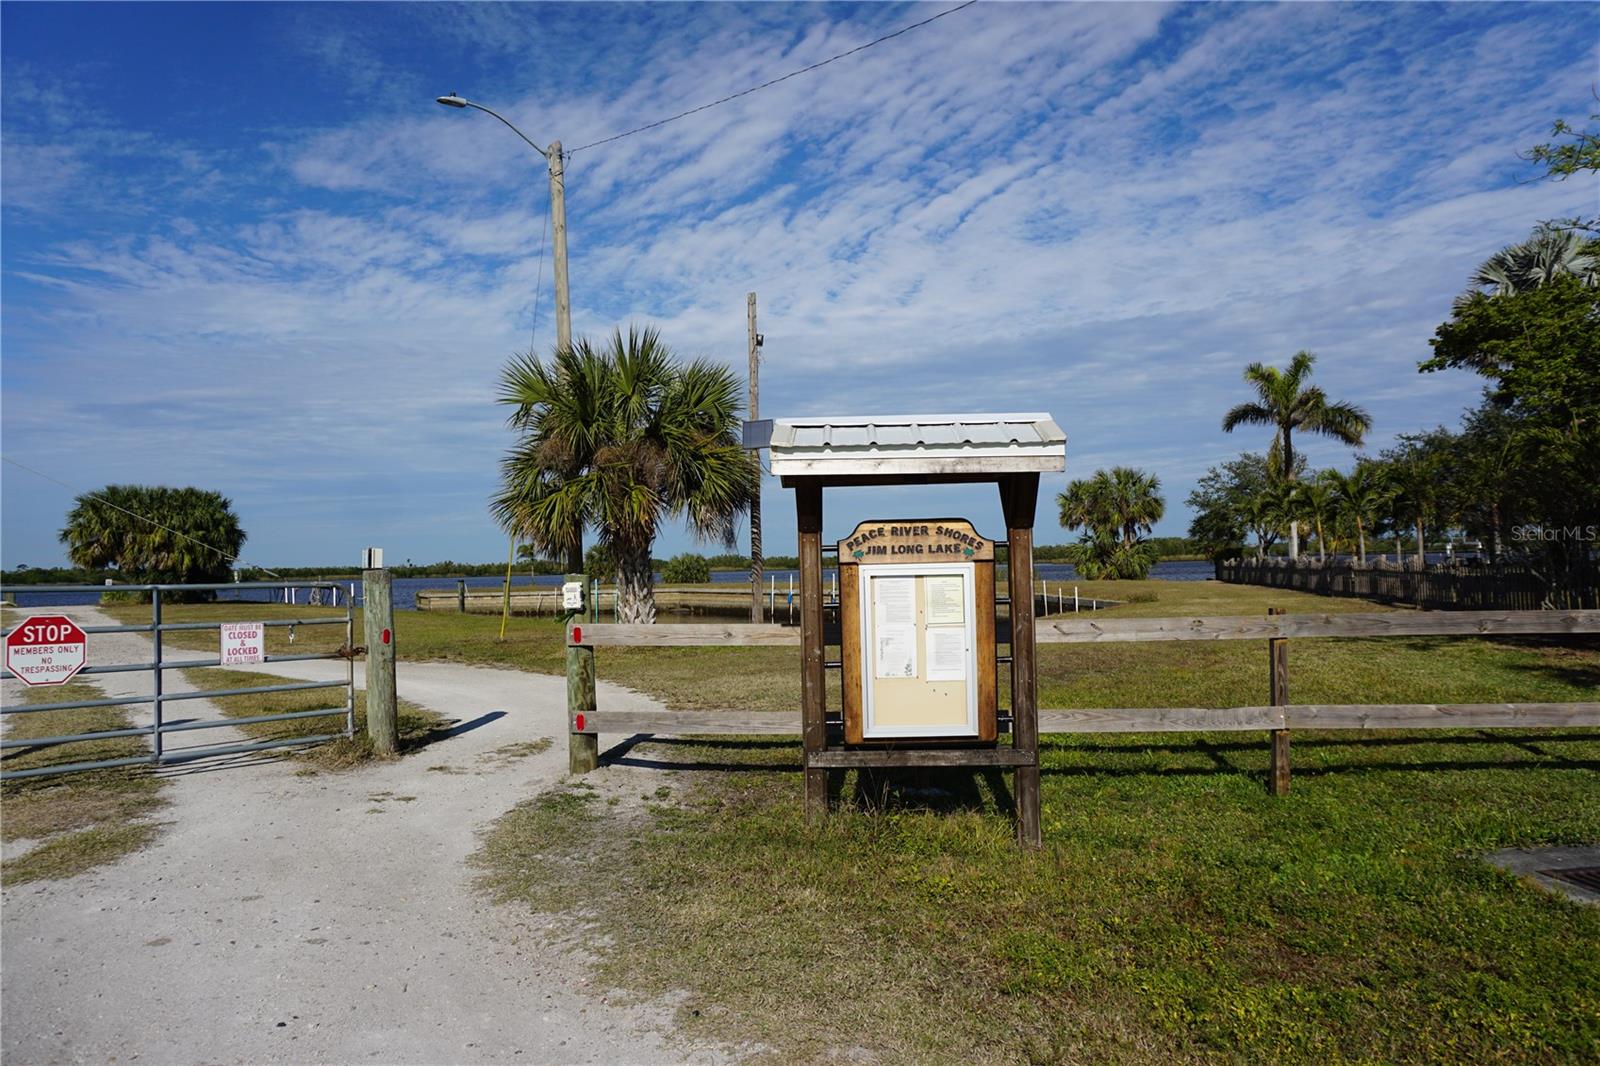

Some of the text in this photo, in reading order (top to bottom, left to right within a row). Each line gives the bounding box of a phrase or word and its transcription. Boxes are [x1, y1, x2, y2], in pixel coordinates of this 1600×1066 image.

[846, 525, 984, 552] PEACE RIVER SHORES
[865, 543, 961, 556] JIM LONG LAKE
[23, 624, 72, 643] STOP
[228, 630, 258, 640] CLOSED
[14, 645, 79, 655] MEMBERS ONLY
[228, 646, 258, 656] LOCKED
[21, 664, 73, 674] TRESPASSING
